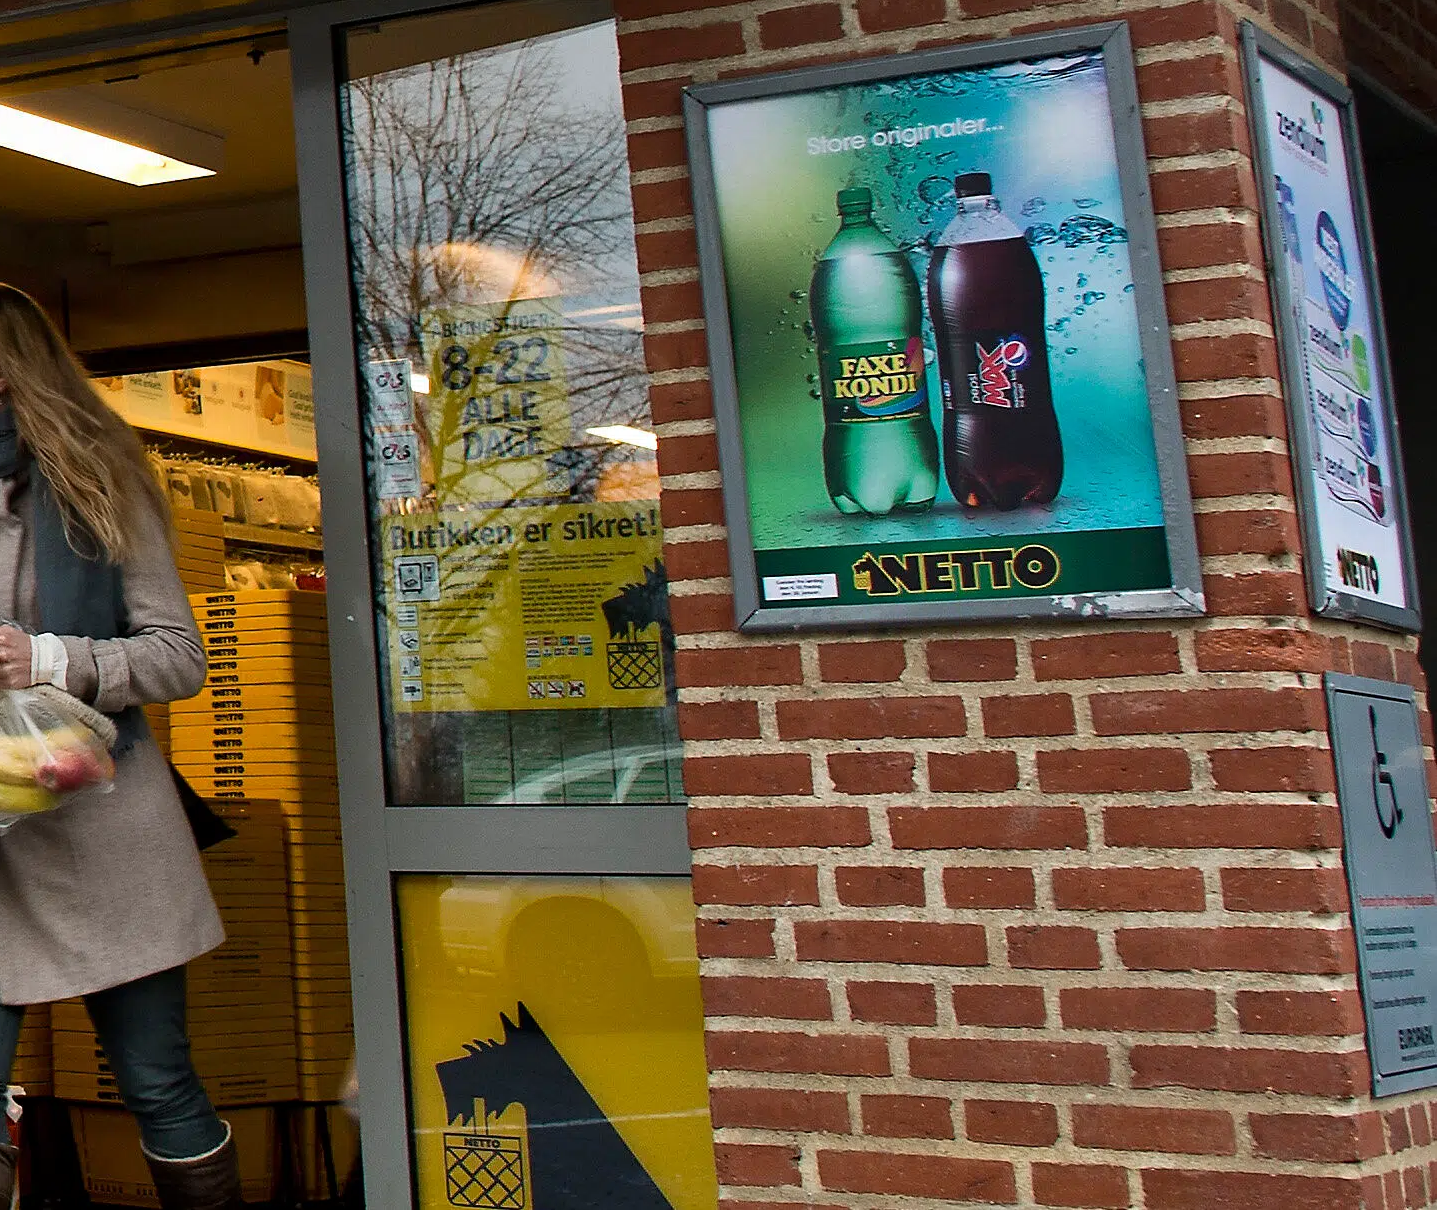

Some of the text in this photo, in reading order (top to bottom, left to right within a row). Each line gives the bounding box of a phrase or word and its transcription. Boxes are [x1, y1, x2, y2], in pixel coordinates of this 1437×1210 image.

[807, 117, 1005, 155] Store originaler...
[441, 337, 551, 390] 8-22
[840, 353, 907, 378] FAXE
[976, 339, 1012, 409] MAX
[833, 374, 916, 399] KONDI
[462, 391, 539, 425] ALLE
[462, 427, 544, 461] DAGE
[390, 509, 657, 550] Butikken er sikret!
[867, 544, 1061, 596] NETTO
[464, 1137, 500, 1148] NETTO
